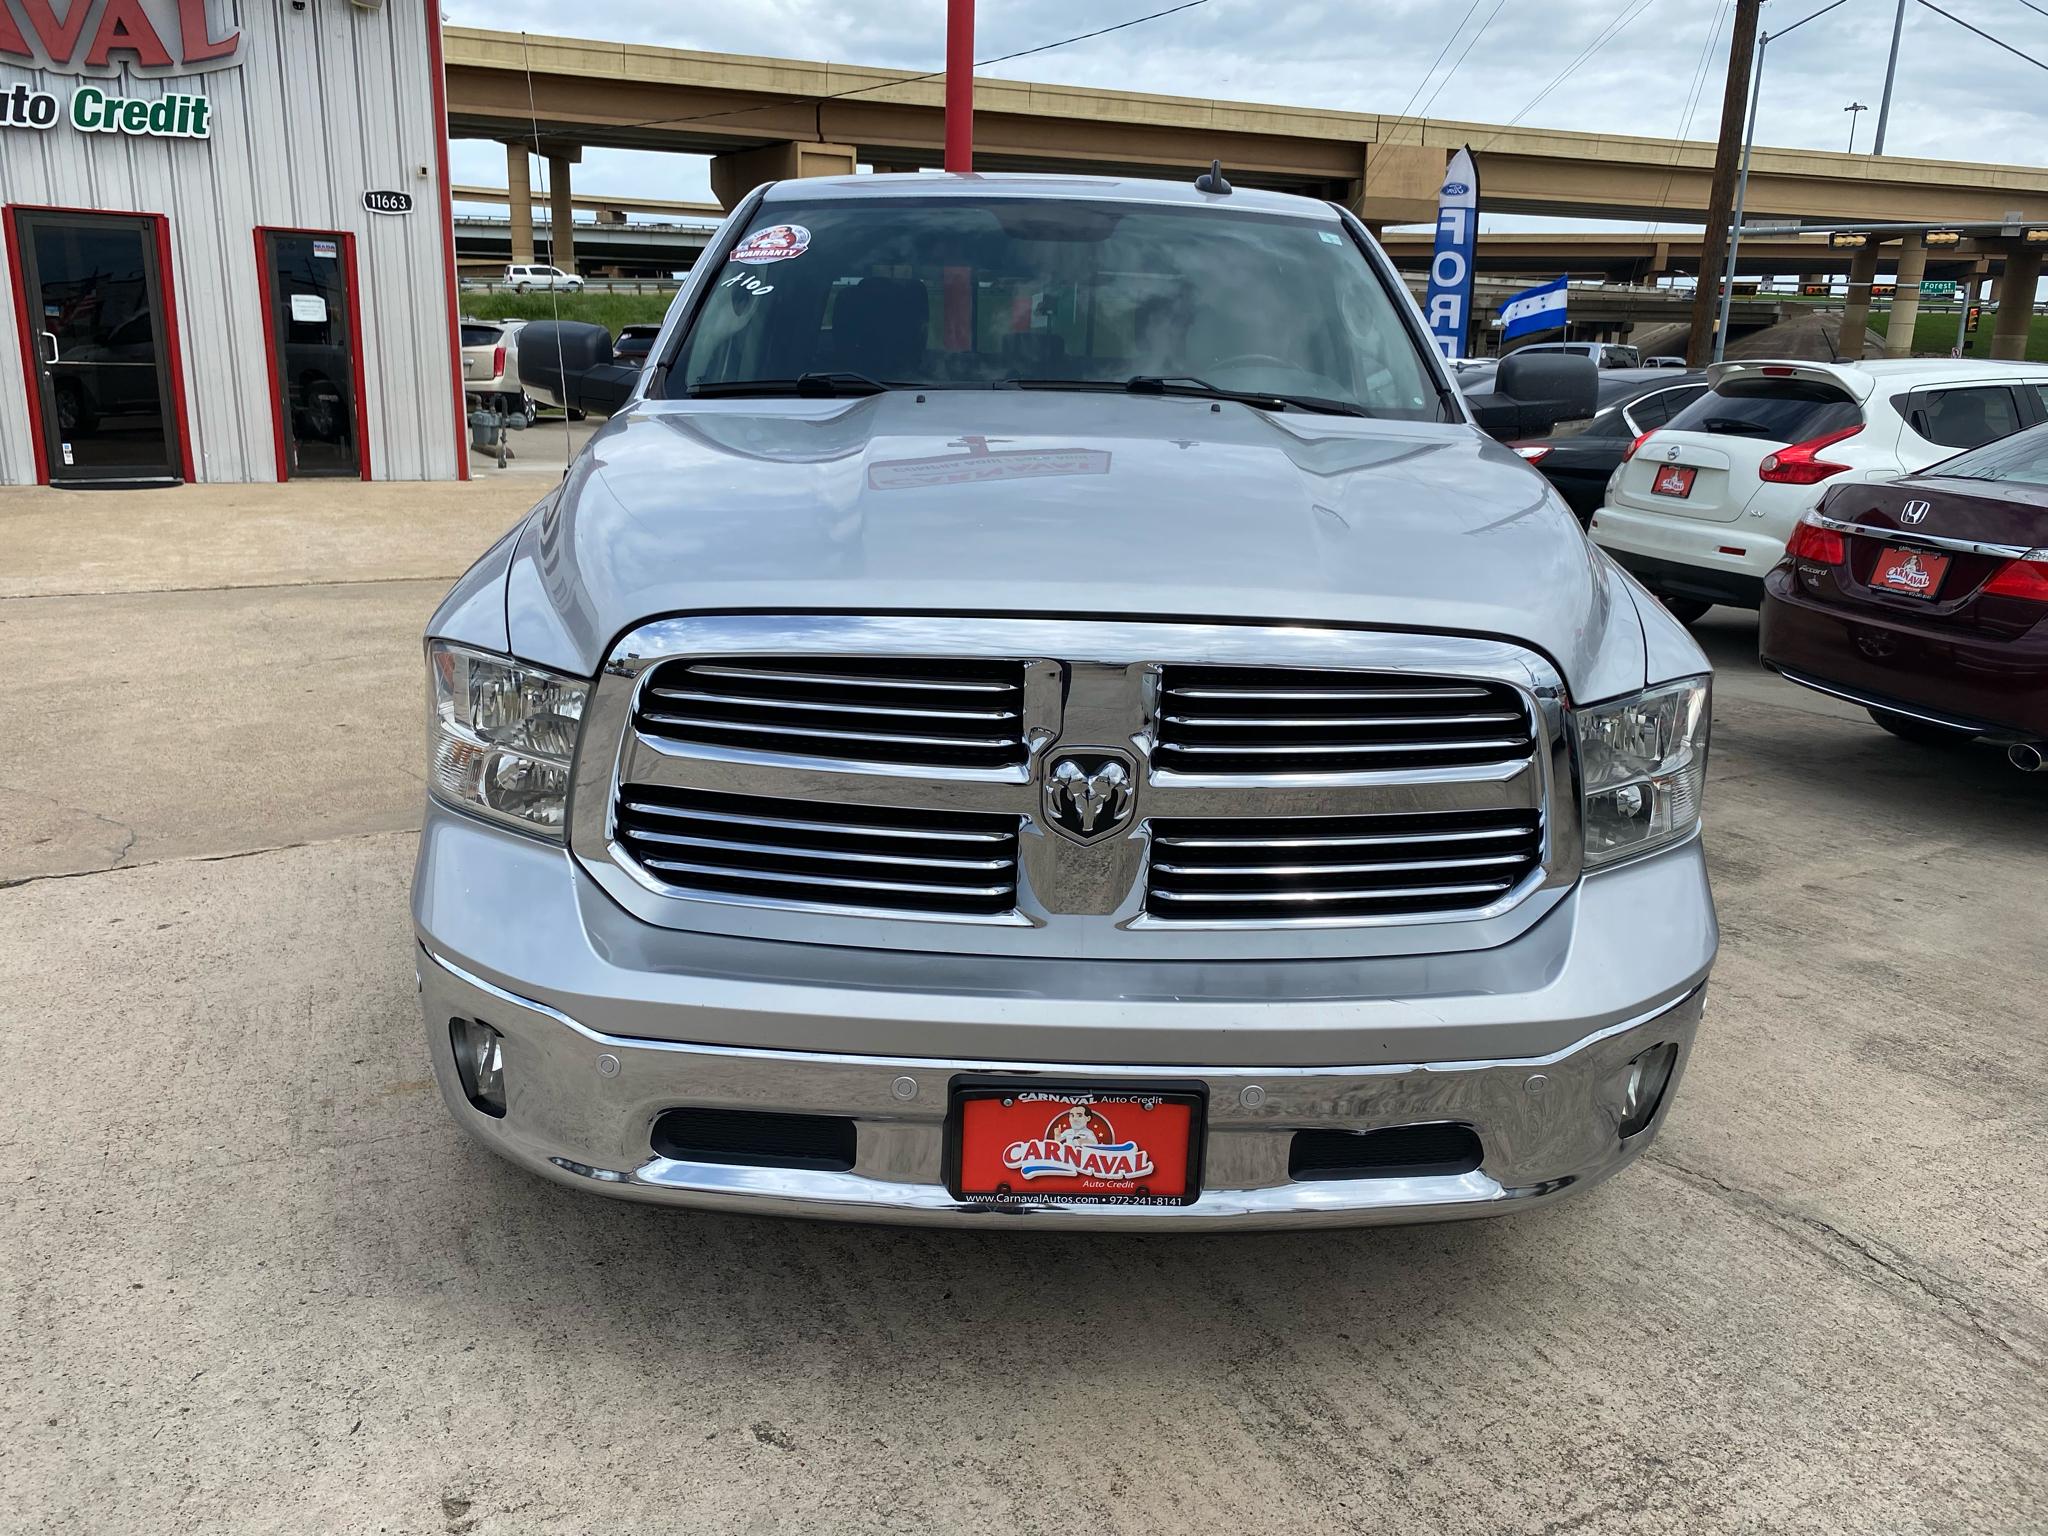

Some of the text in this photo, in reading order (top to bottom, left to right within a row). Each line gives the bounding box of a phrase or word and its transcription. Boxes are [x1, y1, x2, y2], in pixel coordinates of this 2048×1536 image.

[74, 88, 209, 134] Credit
[371, 194, 406, 209] 11663
[735, 249, 797, 258] WARRANTY
[1798, 565, 1828, 576] Accord
[1886, 567, 1930, 587] CARNAVAL
[1018, 1092, 1163, 1105] CARNAVAL Auto Credit
[1003, 1140, 1154, 1178] CARNAVAL
[1082, 1180, 1135, 1189] Auto Credit
[965, 1193, 1182, 1206] www.CarnavalAutos.com 972-241-8141
